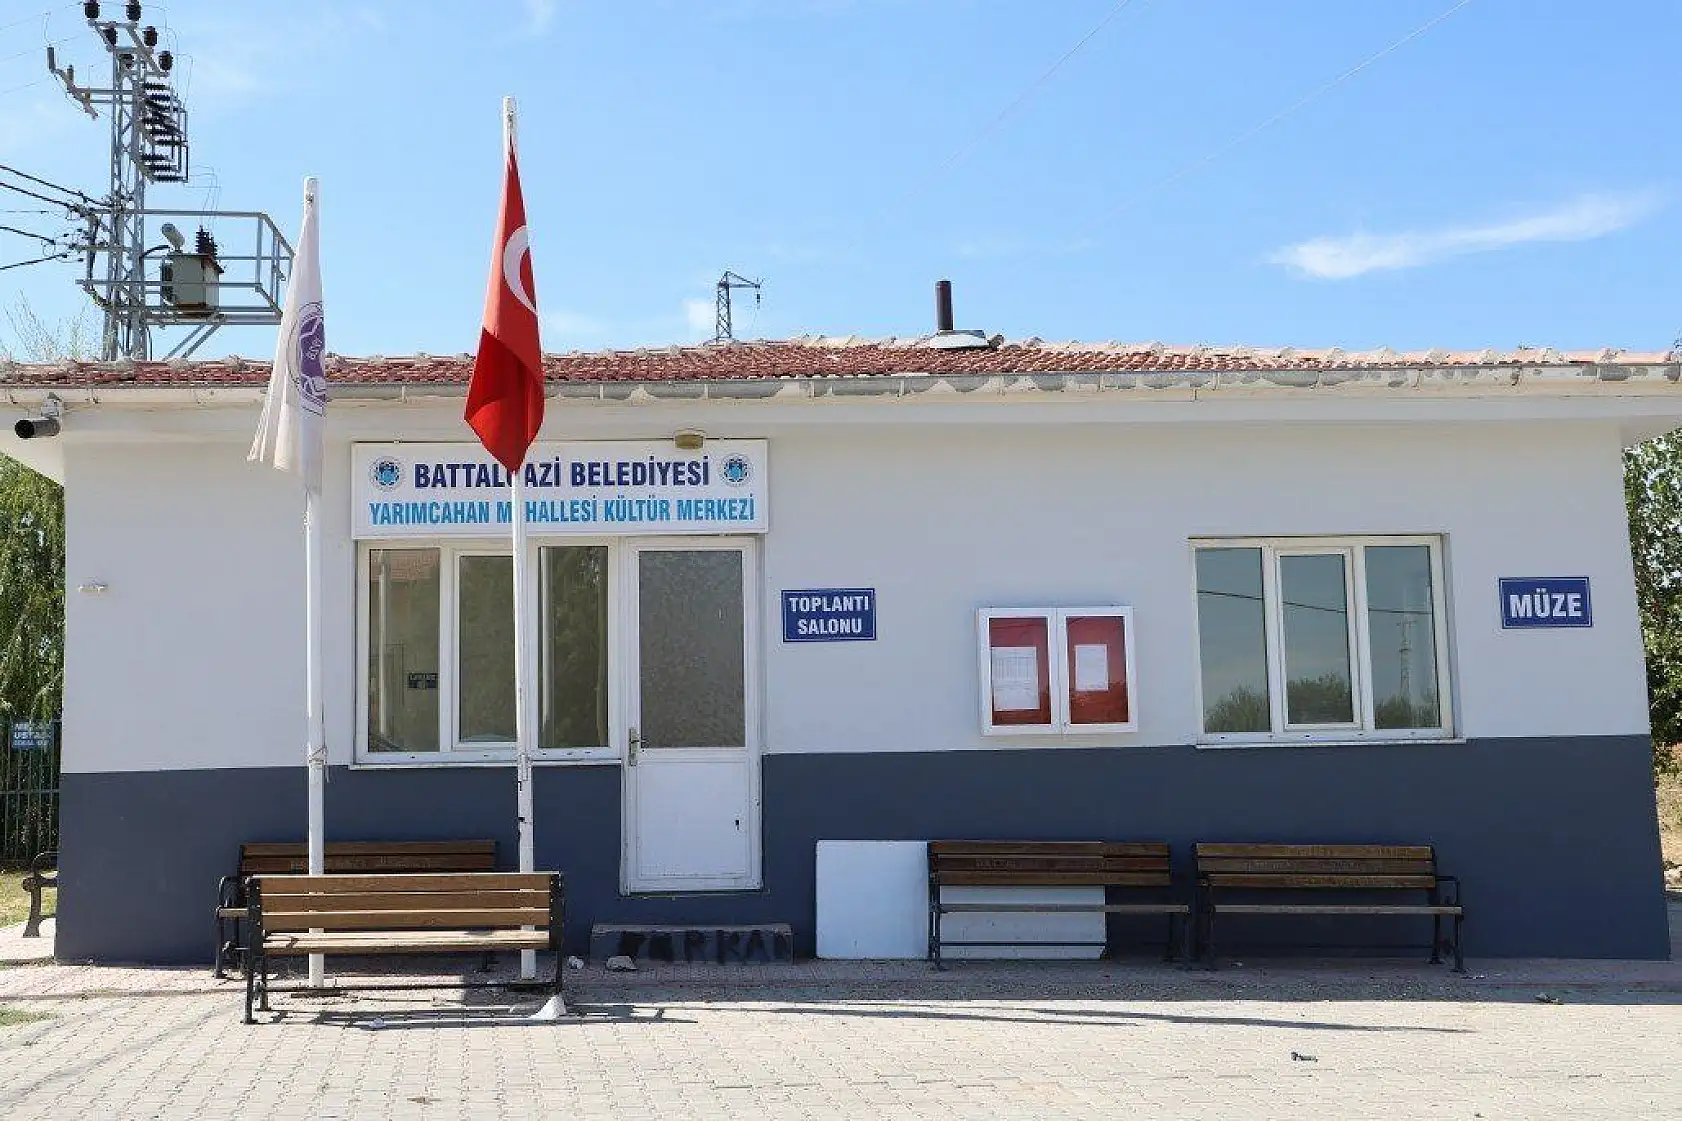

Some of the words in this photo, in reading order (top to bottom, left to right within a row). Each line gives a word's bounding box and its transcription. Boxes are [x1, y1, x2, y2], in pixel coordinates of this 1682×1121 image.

[571, 455, 710, 487] BELEDİYESİ
[369, 500, 490, 525] YARIMCAHAN
[496, 495, 597, 524] MHALLESİ
[605, 494, 671, 522] KÜLTÜR
[676, 493, 755, 522] MERKEZİ
[789, 596, 869, 612] TOPLANTI
[1509, 587, 1582, 618] MÜZE
[797, 618, 862, 635] SALONU
